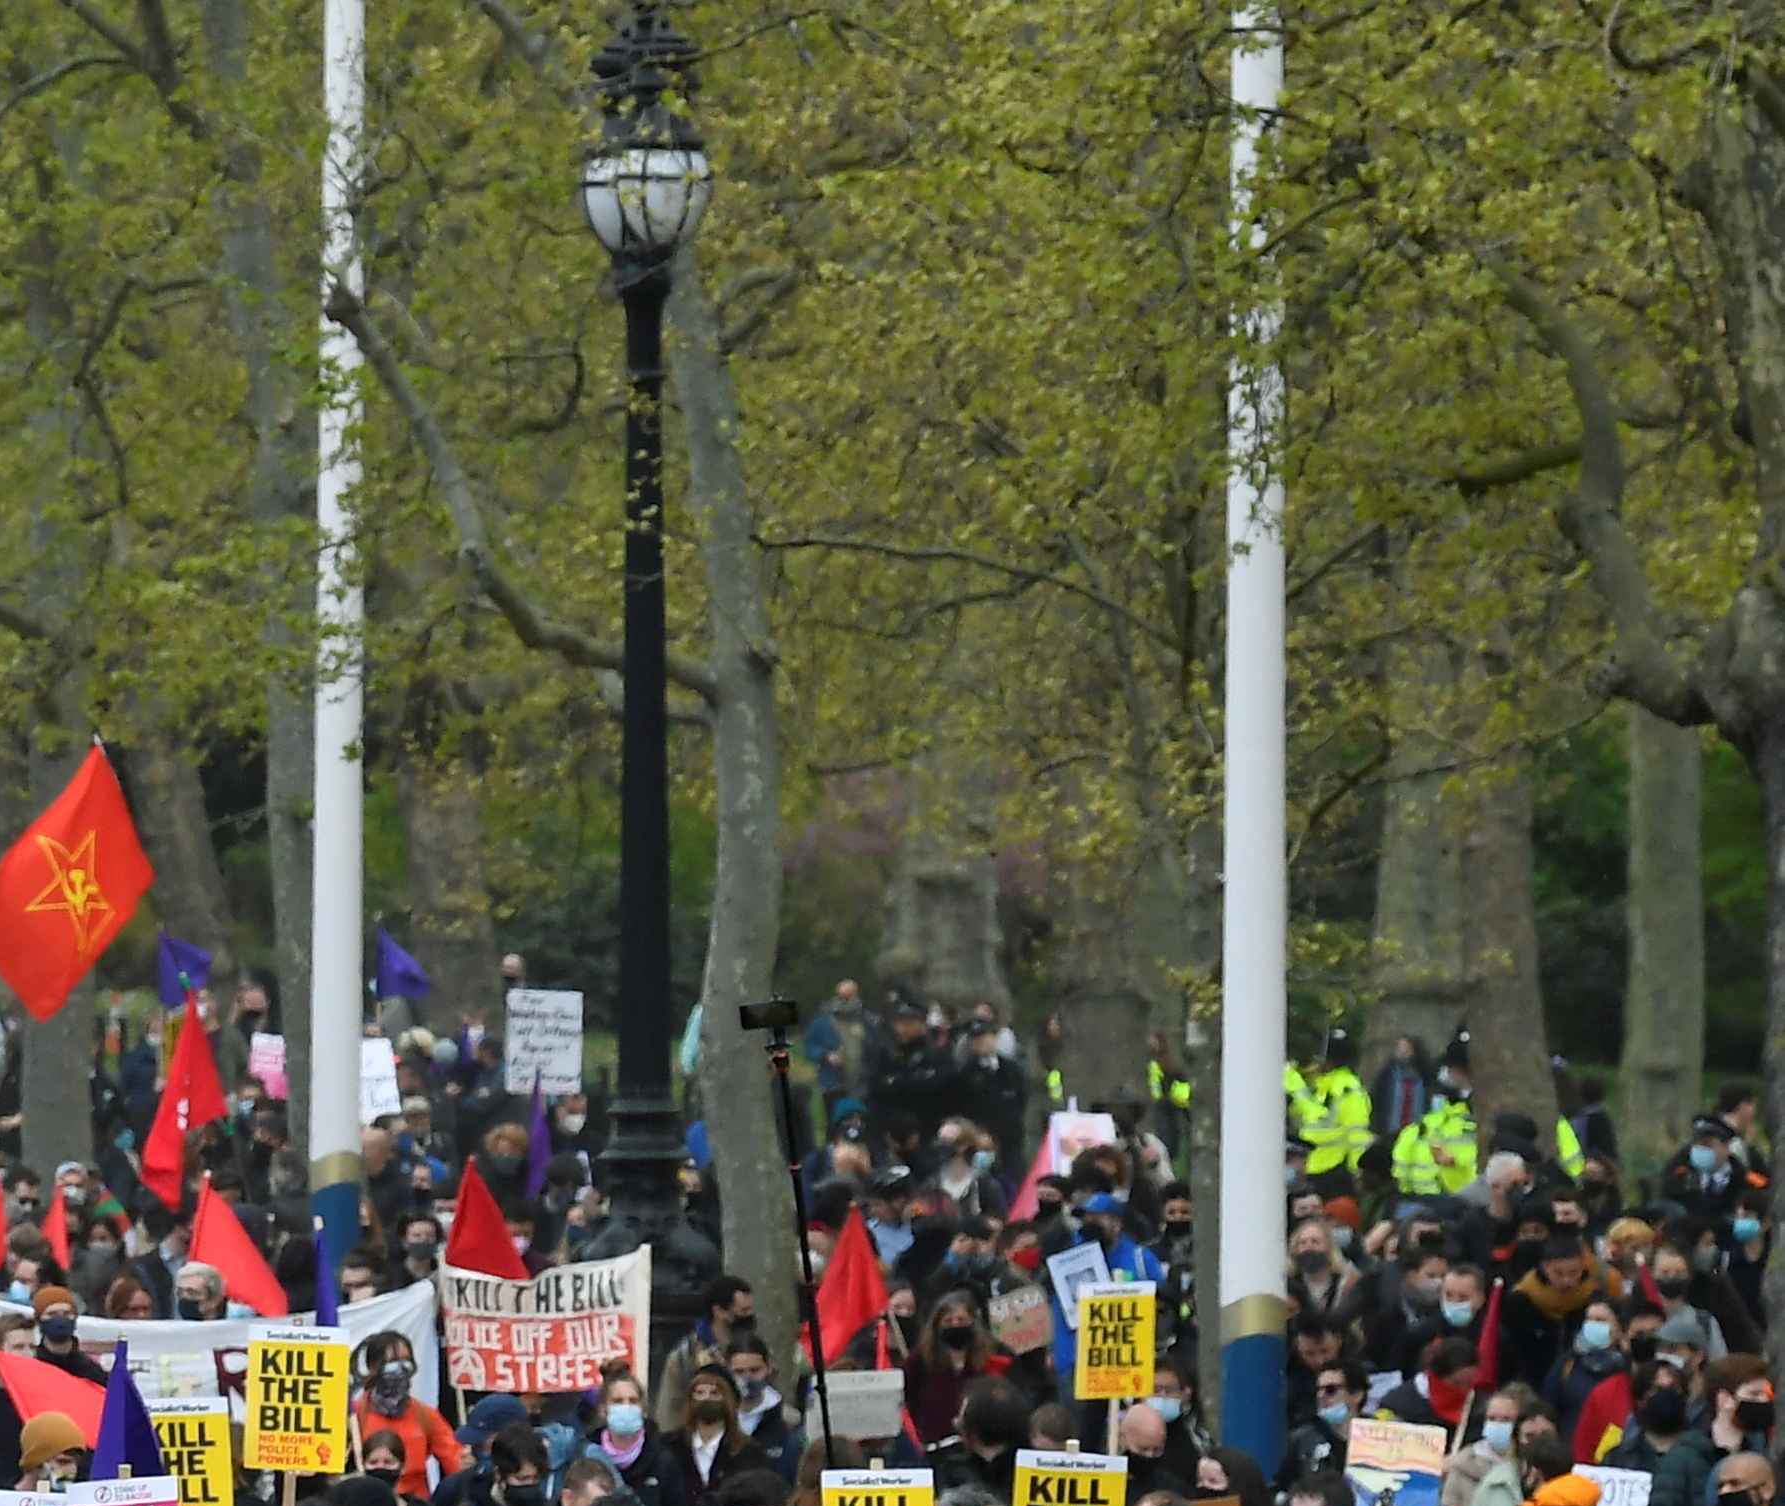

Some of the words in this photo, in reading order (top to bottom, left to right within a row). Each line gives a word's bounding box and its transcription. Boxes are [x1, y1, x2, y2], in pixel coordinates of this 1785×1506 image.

[455, 1277, 503, 1312] KILL
[1090, 1302, 1143, 1323] KILL
[510, 1317, 554, 1355] OFF
[1088, 1323, 1135, 1345] THE
[261, 1347, 335, 1378] KILL
[1088, 1346, 1143, 1368] BILL
[259, 1376, 323, 1406] THE
[259, 1405, 333, 1436] BILL
[1028, 1475, 1110, 1506] KILL
